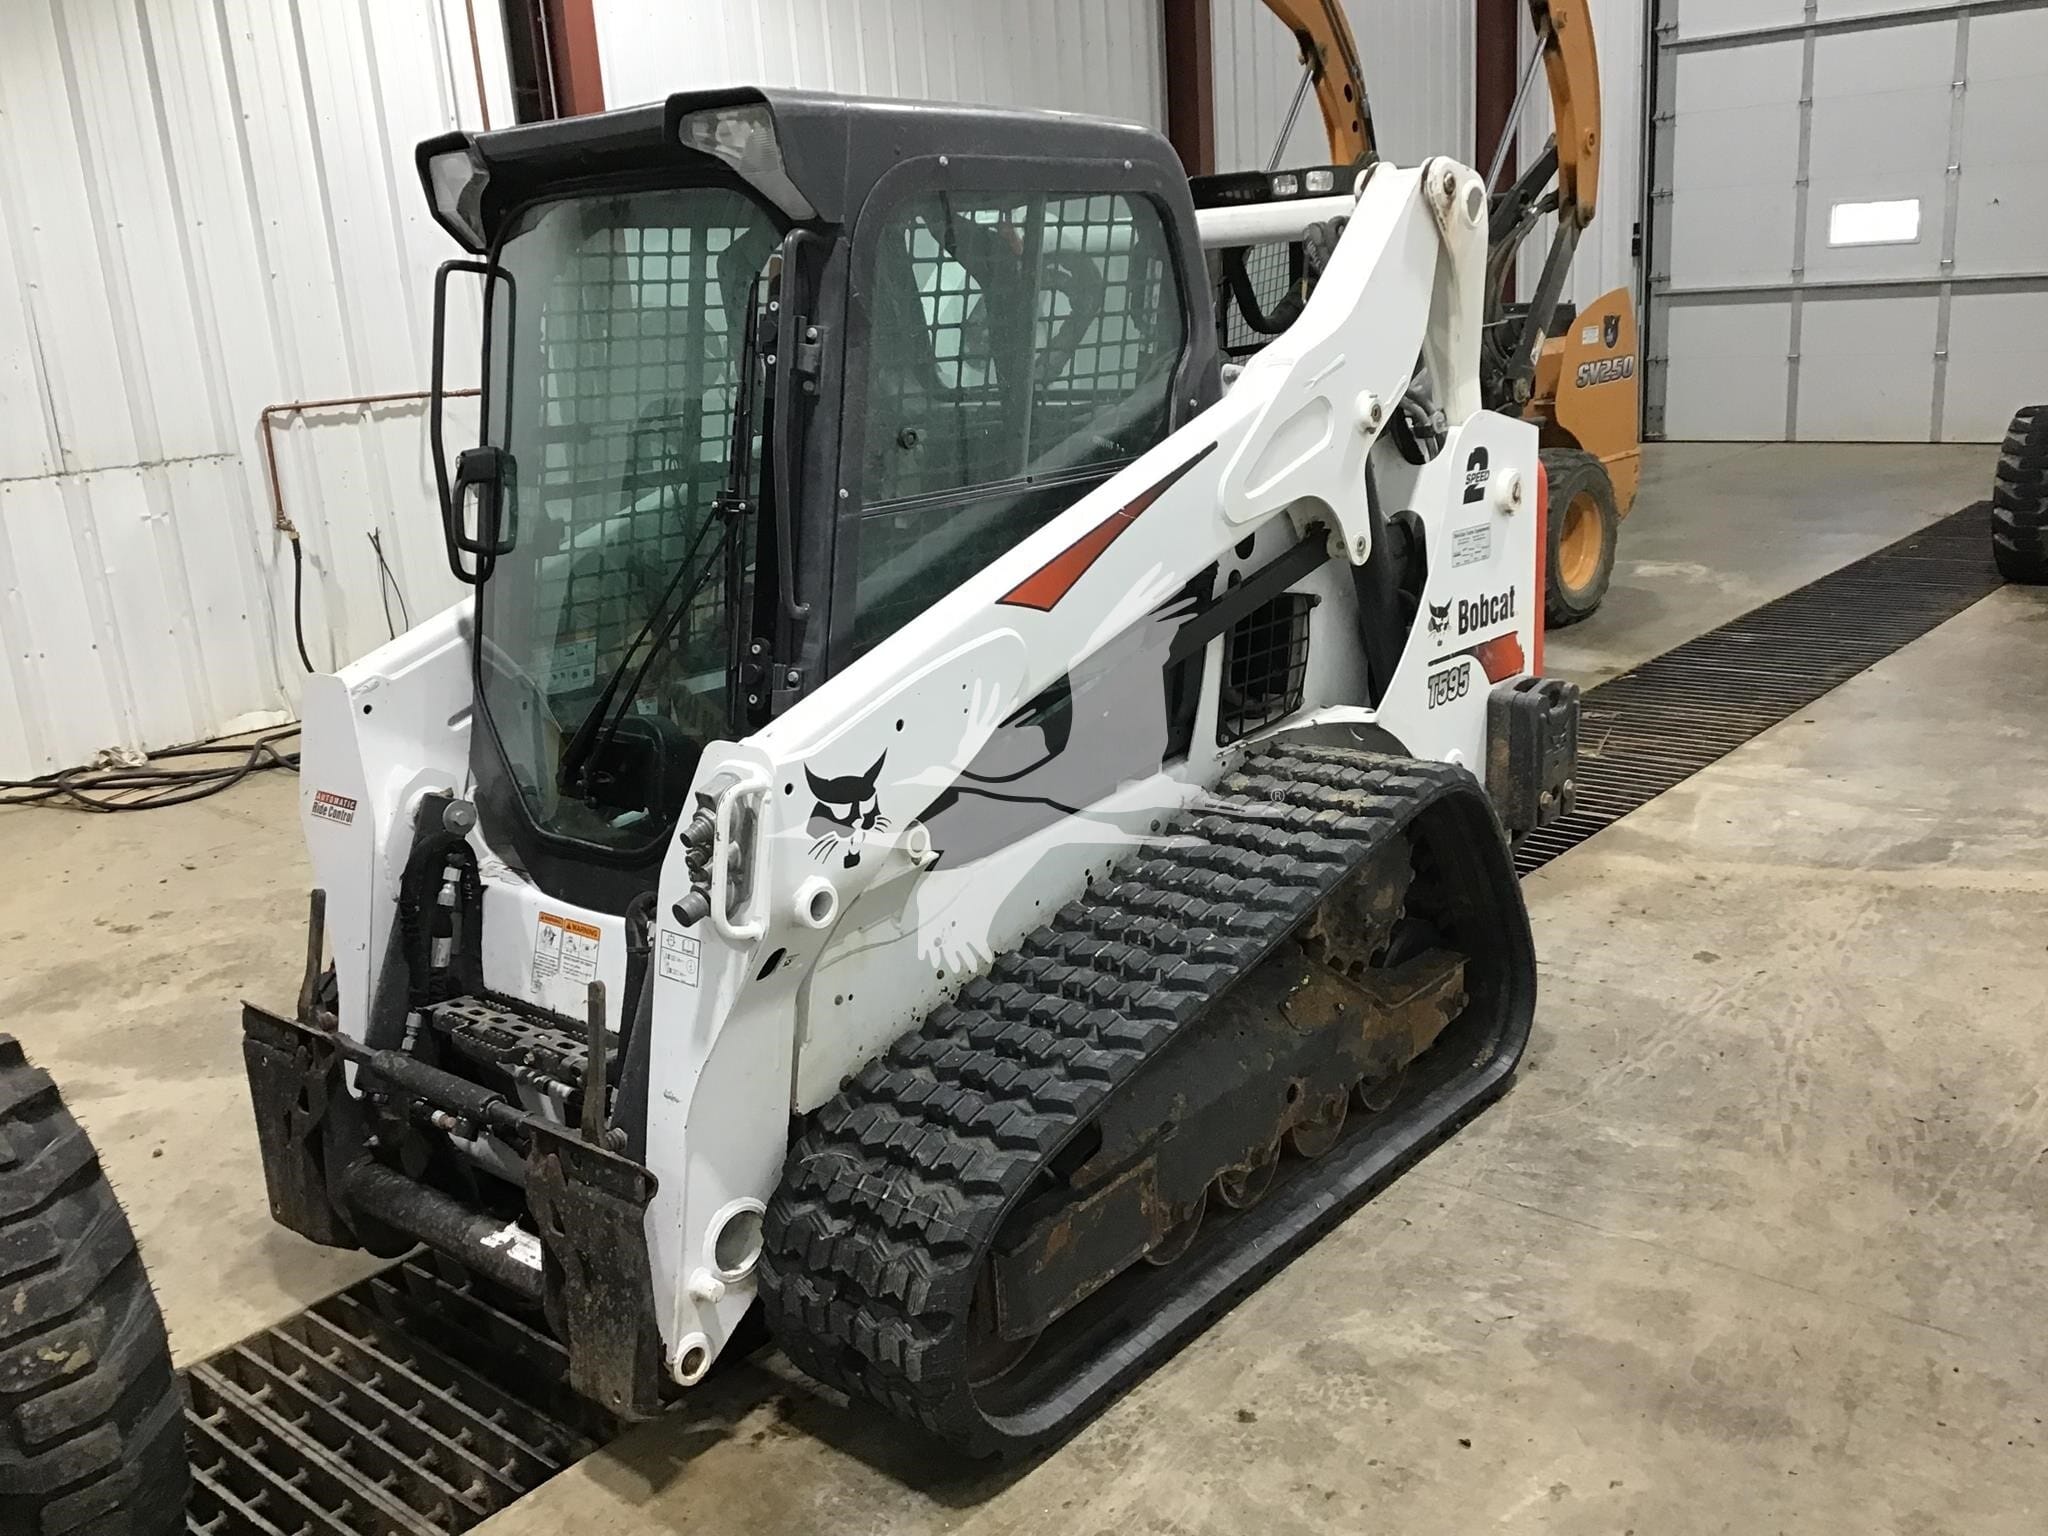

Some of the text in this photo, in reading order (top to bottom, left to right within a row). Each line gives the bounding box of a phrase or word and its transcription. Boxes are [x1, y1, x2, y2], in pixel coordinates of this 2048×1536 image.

[1576, 355, 1635, 388] SV250
[1463, 446, 1489, 505] 2
[1465, 470, 1490, 485] SPEED
[1458, 585, 1515, 636] Bobcat
[1428, 661, 1470, 709] T595
[312, 801, 354, 823] Ride Control
[316, 791, 356, 809] AUTOMATIC
[572, 923, 598, 938] WARNING
